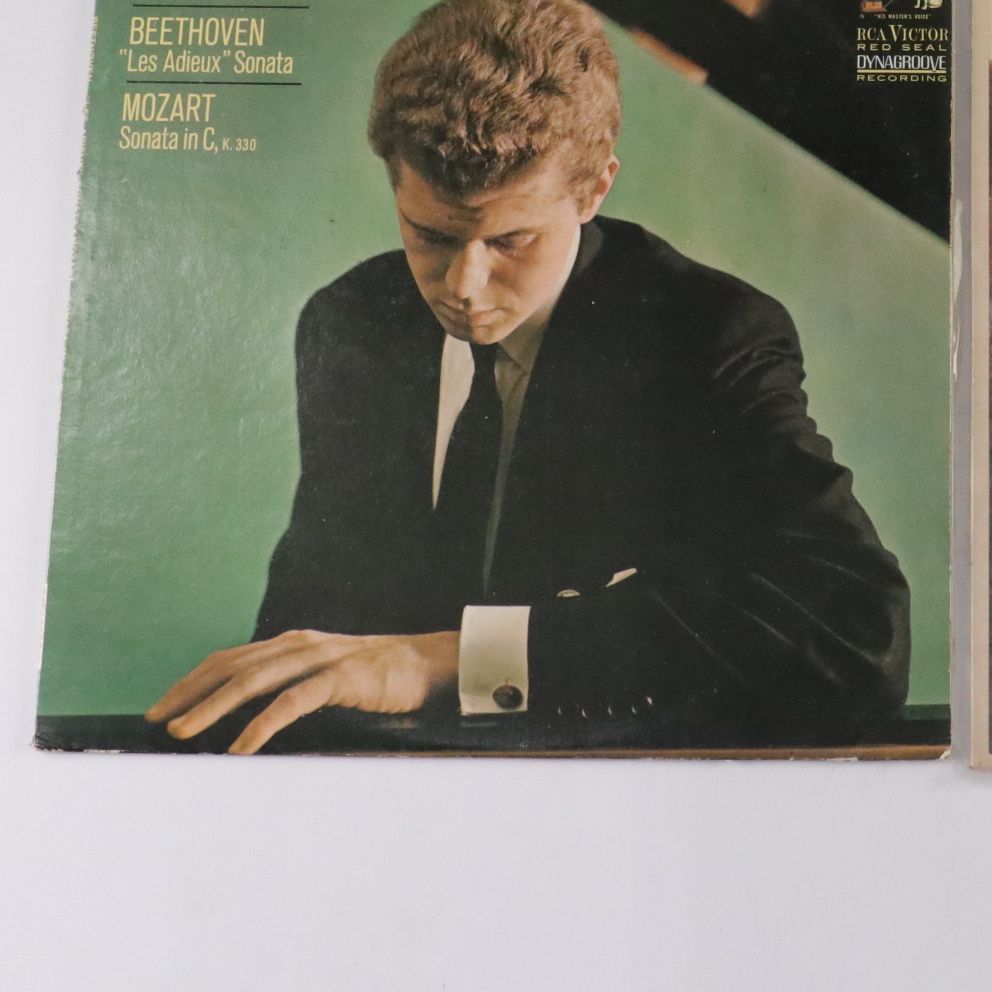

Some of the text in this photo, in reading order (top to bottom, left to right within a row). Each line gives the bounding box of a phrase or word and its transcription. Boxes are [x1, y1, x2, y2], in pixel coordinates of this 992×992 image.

[128, 16, 264, 46] BEETHOVEN
[856, 24, 948, 42] RCA VICTOR
[856, 43, 948, 52] RED SEAL
[234, 50, 294, 74] Sonata
[856, 54, 946, 72] DYNAGROOVE
[856, 74, 947, 82] RECORDING
[121, 92, 216, 122] MOZART
[118, 125, 256, 153] Sonata in C, K. 330
